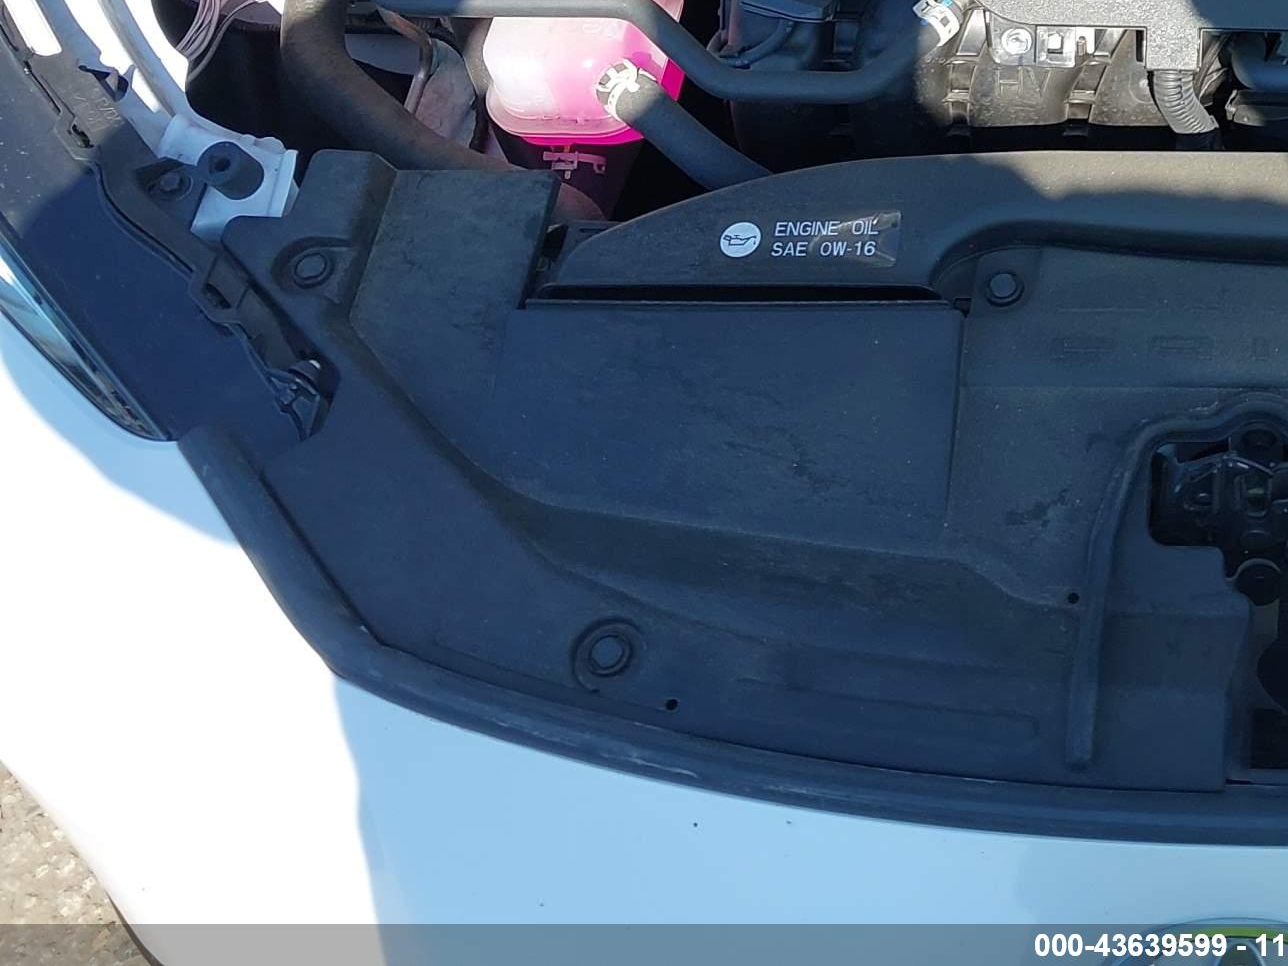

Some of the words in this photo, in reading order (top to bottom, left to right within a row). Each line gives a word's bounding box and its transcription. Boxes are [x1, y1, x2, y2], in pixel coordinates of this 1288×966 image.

[774, 220, 840, 237] ENGINE
[851, 220, 879, 237] OIL
[771, 240, 807, 258] SAE
[819, 240, 876, 257] 0W-16
